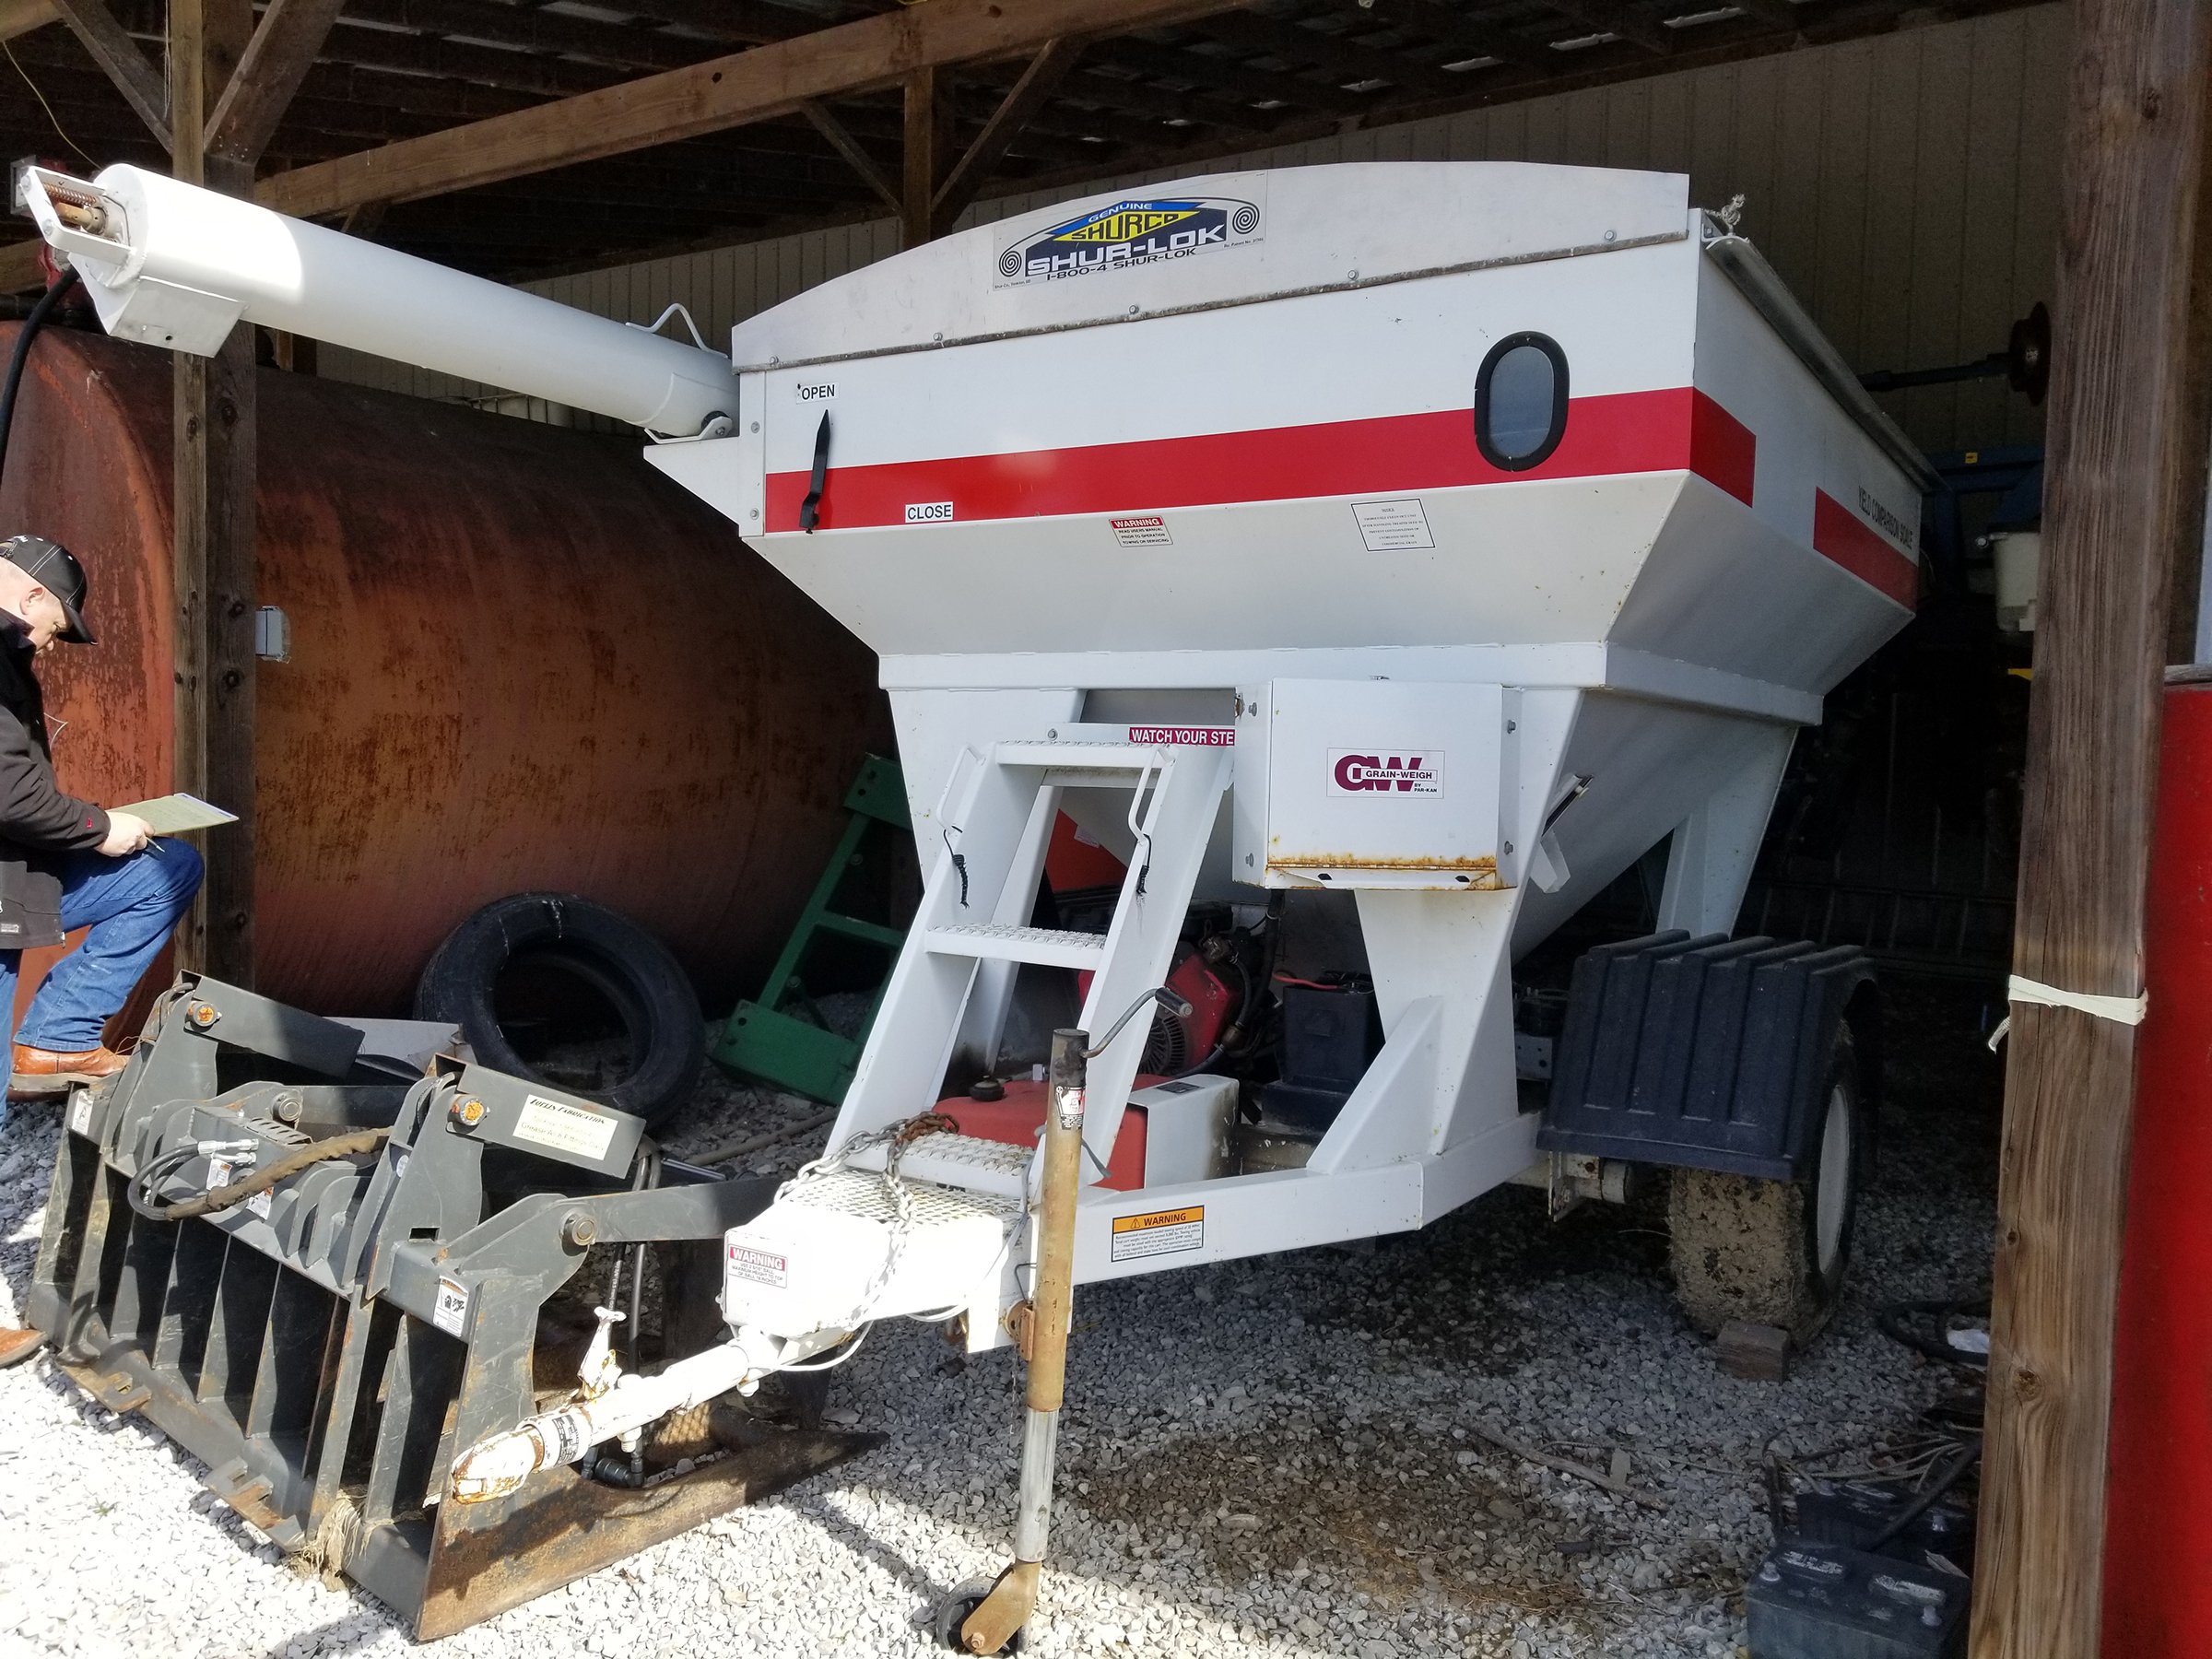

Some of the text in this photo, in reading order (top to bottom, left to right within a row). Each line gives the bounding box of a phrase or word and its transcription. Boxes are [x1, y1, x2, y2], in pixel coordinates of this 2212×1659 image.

[1088, 203, 1152, 223] GENUINE
[1071, 213, 1179, 241] SHURCO
[1027, 224, 1226, 276] SHUR-LOK
[1046, 247, 1196, 281] 1-800-4 SHUR-LOK
[801, 384, 835, 400] OPEN
[907, 504, 951, 520] CLOSE
[1113, 519, 1160, 528] WARNING
[1131, 729, 1234, 745] WATCH YOUR STE
[1366, 771, 1432, 780] GRAIN-WEIGH
[558, 1107, 606, 1125] FABRICATION
[1144, 1213, 1186, 1226] WARNING
[734, 1249, 783, 1270] WARNING
